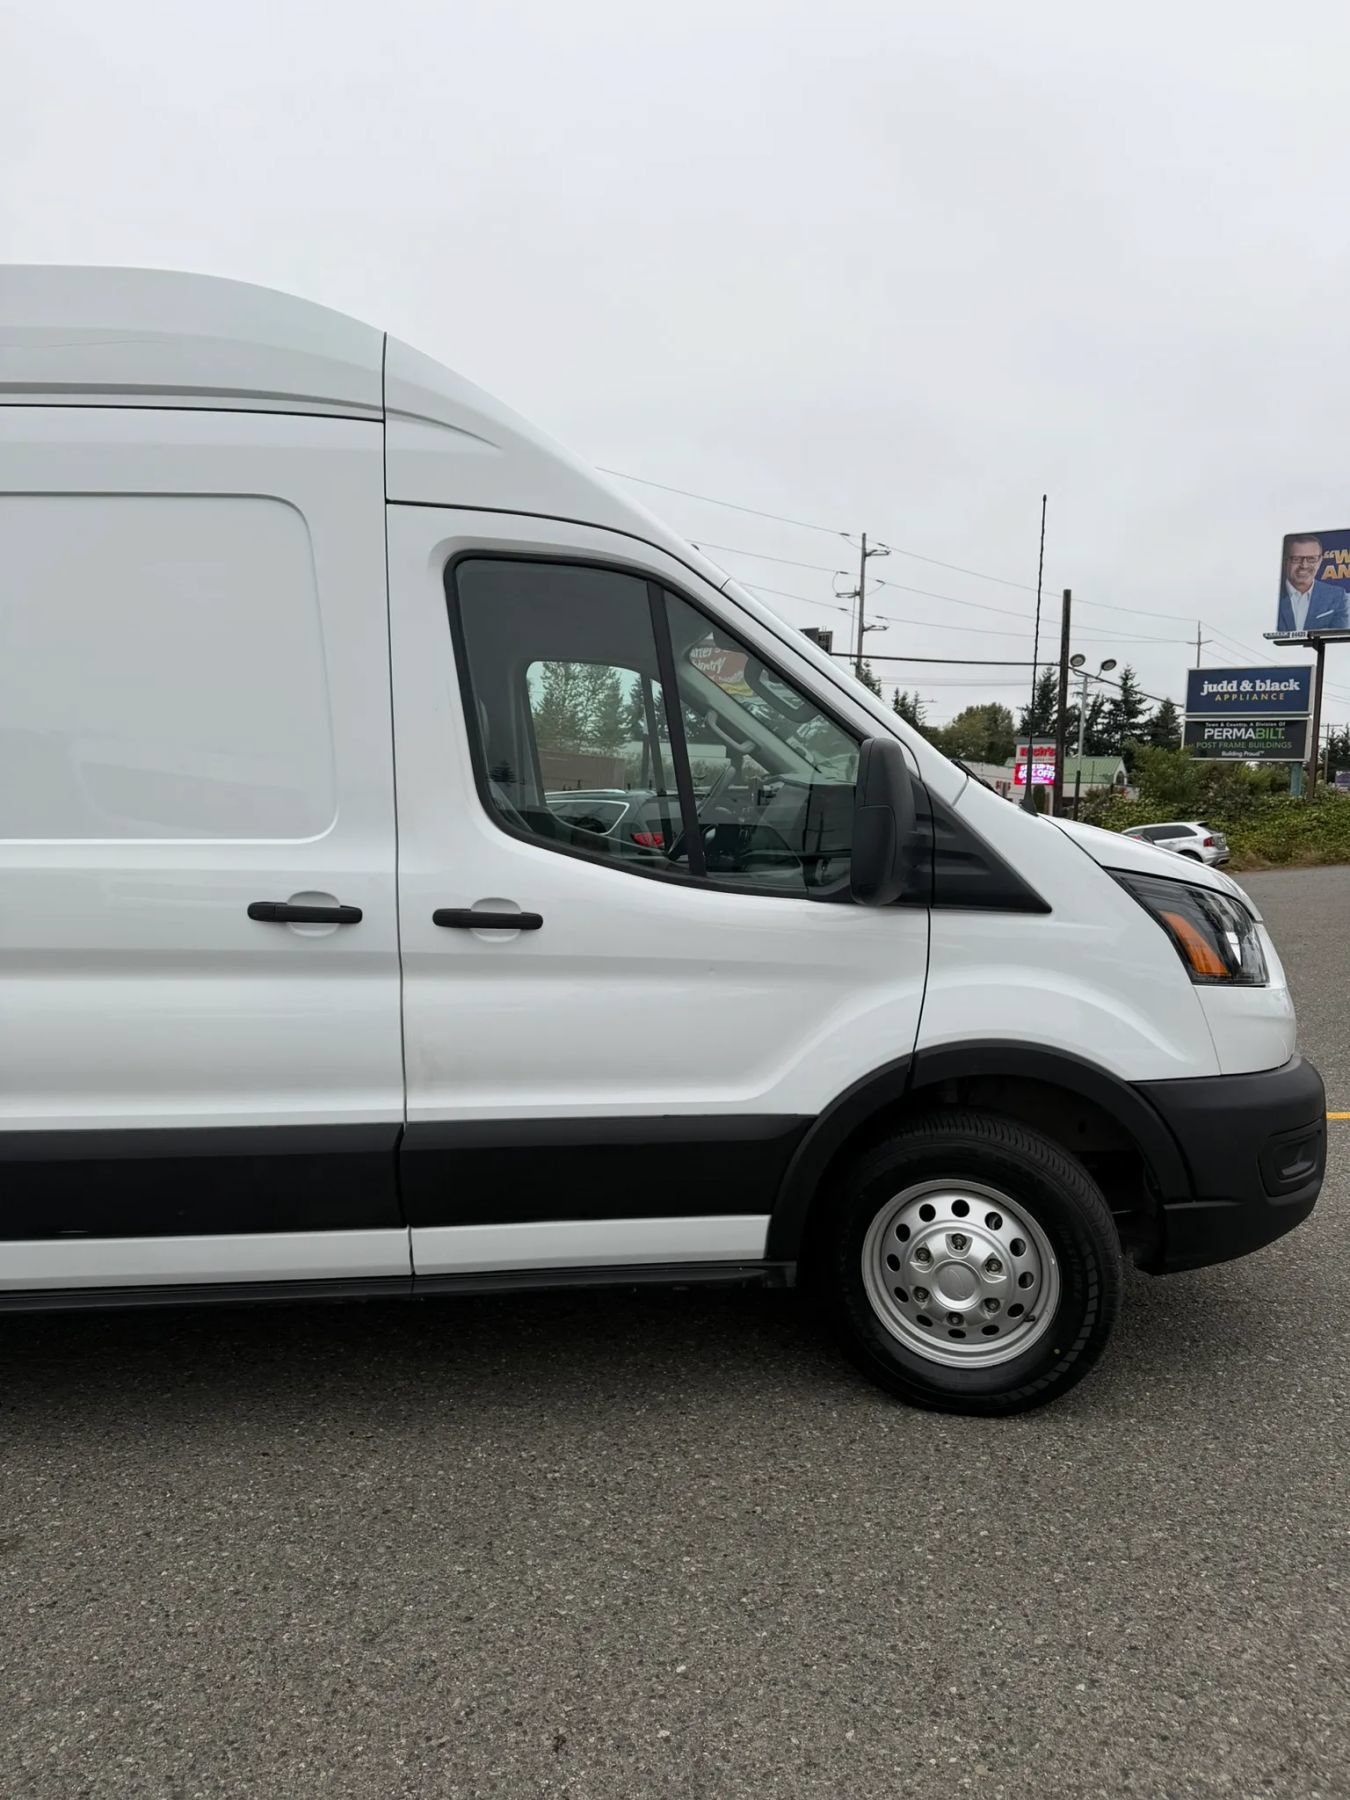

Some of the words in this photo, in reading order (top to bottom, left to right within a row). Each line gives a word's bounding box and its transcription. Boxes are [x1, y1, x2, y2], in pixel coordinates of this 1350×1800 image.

[1200, 680, 1238, 696] judd
[1240, 680, 1253, 692] &
[1255, 679, 1300, 692] black
[1215, 693, 1285, 702] APPLIANCE
[1196, 741, 1217, 749] POST
[1219, 741, 1246, 749] FRAME
[1248, 741, 1292, 749] BUILDINGS
